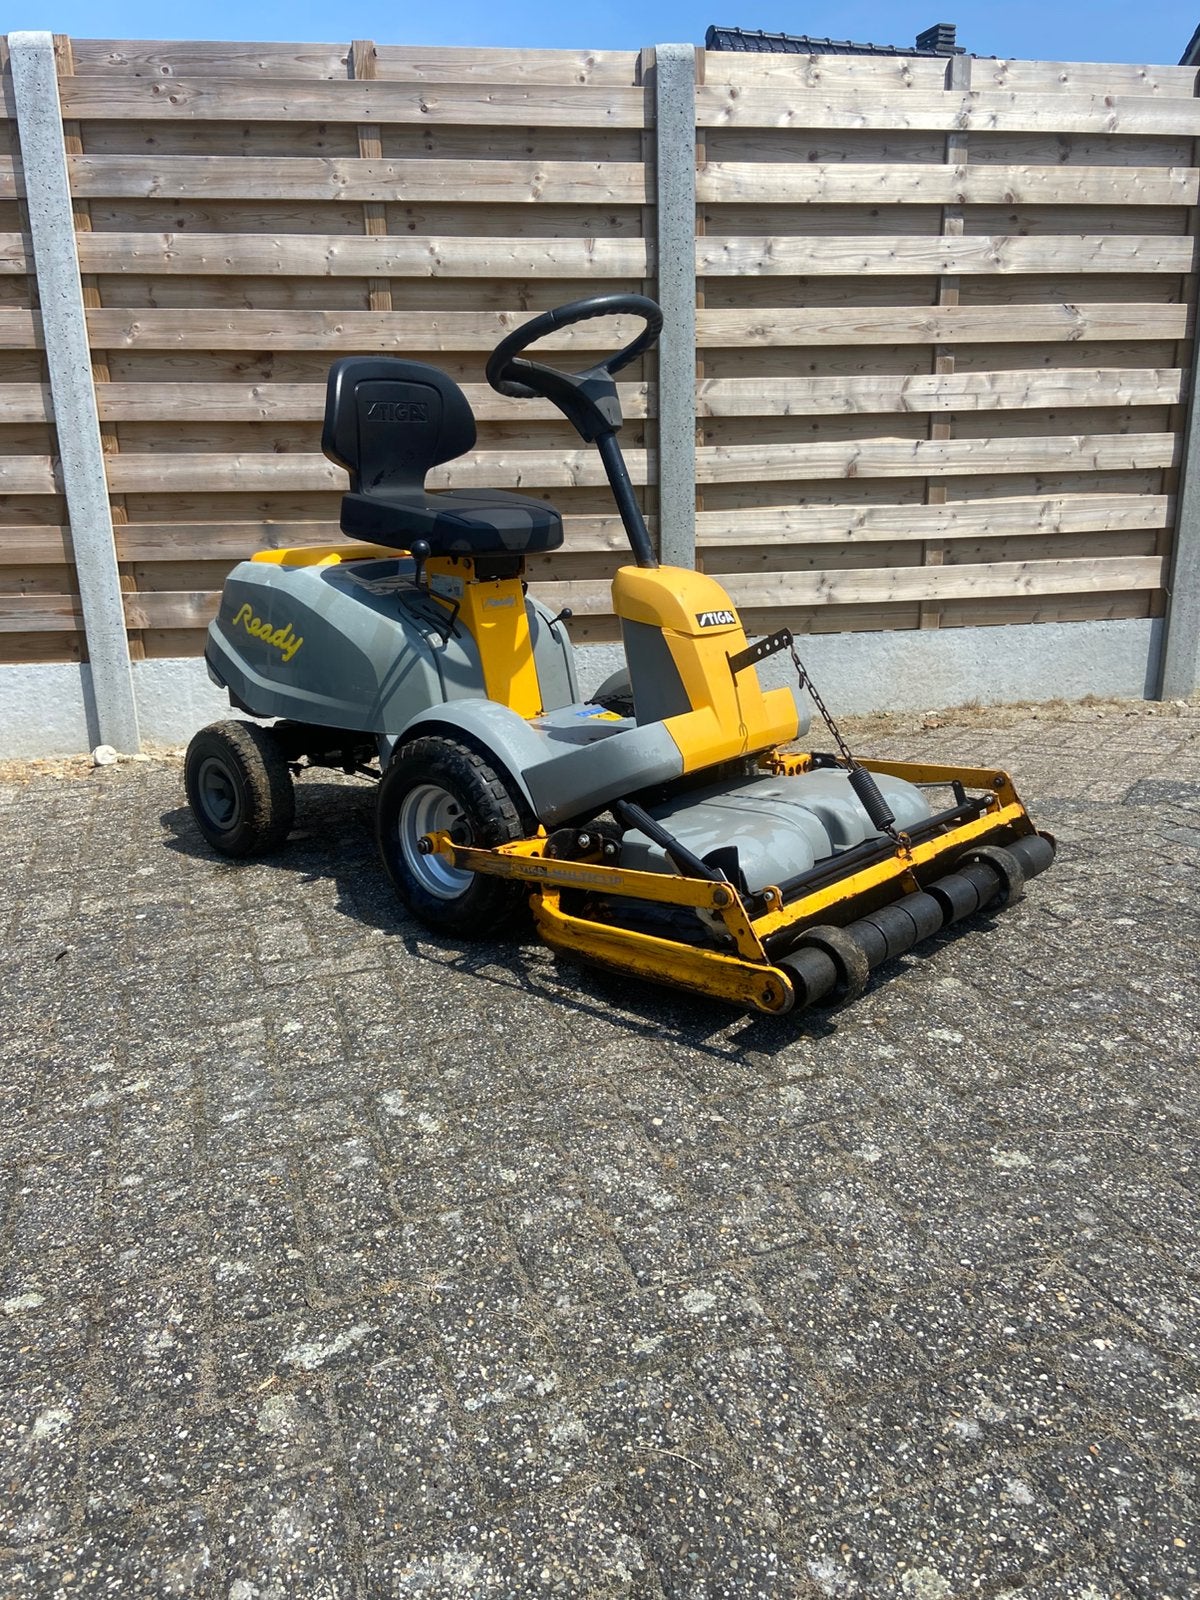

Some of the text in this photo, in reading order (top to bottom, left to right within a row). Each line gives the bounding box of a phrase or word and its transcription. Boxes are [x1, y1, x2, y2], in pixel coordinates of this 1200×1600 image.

[367, 402, 427, 421] STIGA
[699, 611, 735, 627] STIGA
[232, 603, 304, 662] Ready
